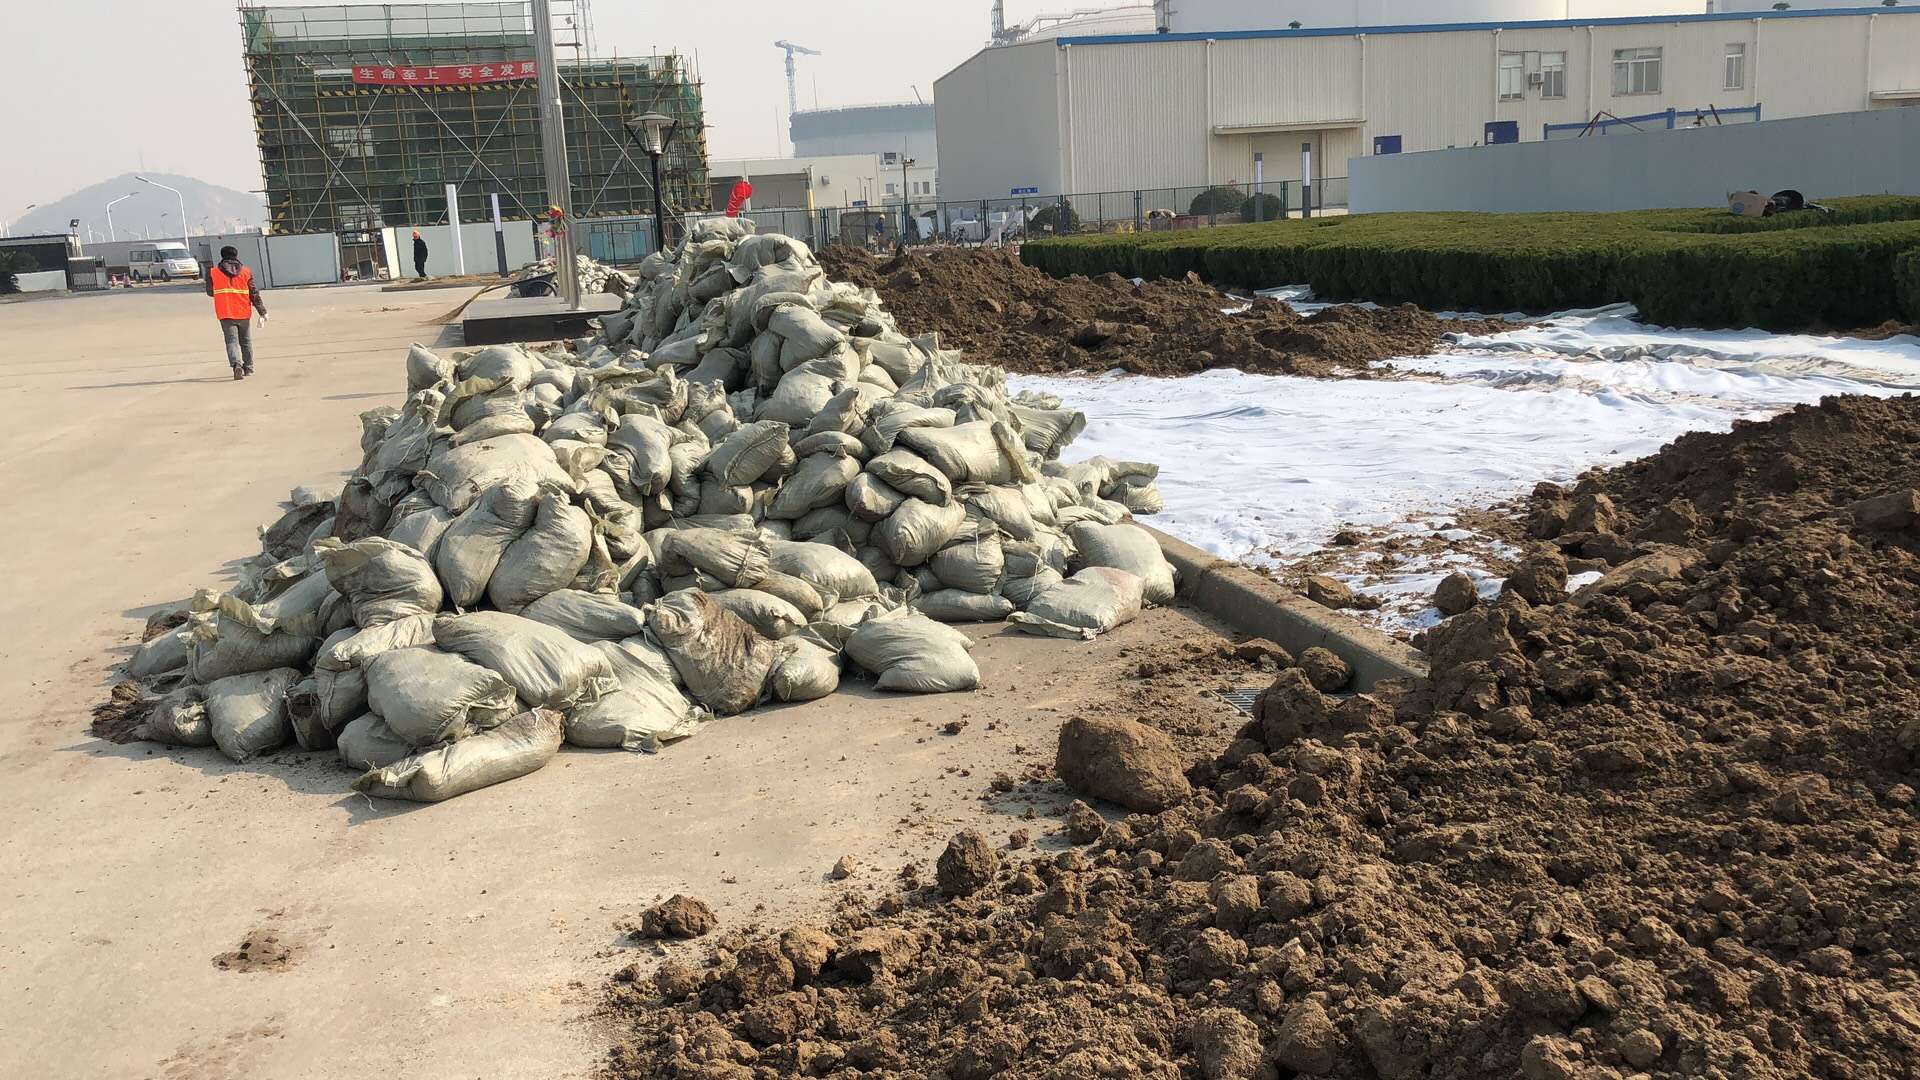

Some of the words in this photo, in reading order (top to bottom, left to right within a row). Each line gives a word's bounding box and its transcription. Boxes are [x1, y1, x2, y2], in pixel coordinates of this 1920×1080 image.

[359, 68, 440, 80] 生命至上
[457, 62, 536, 79] 安全发展
